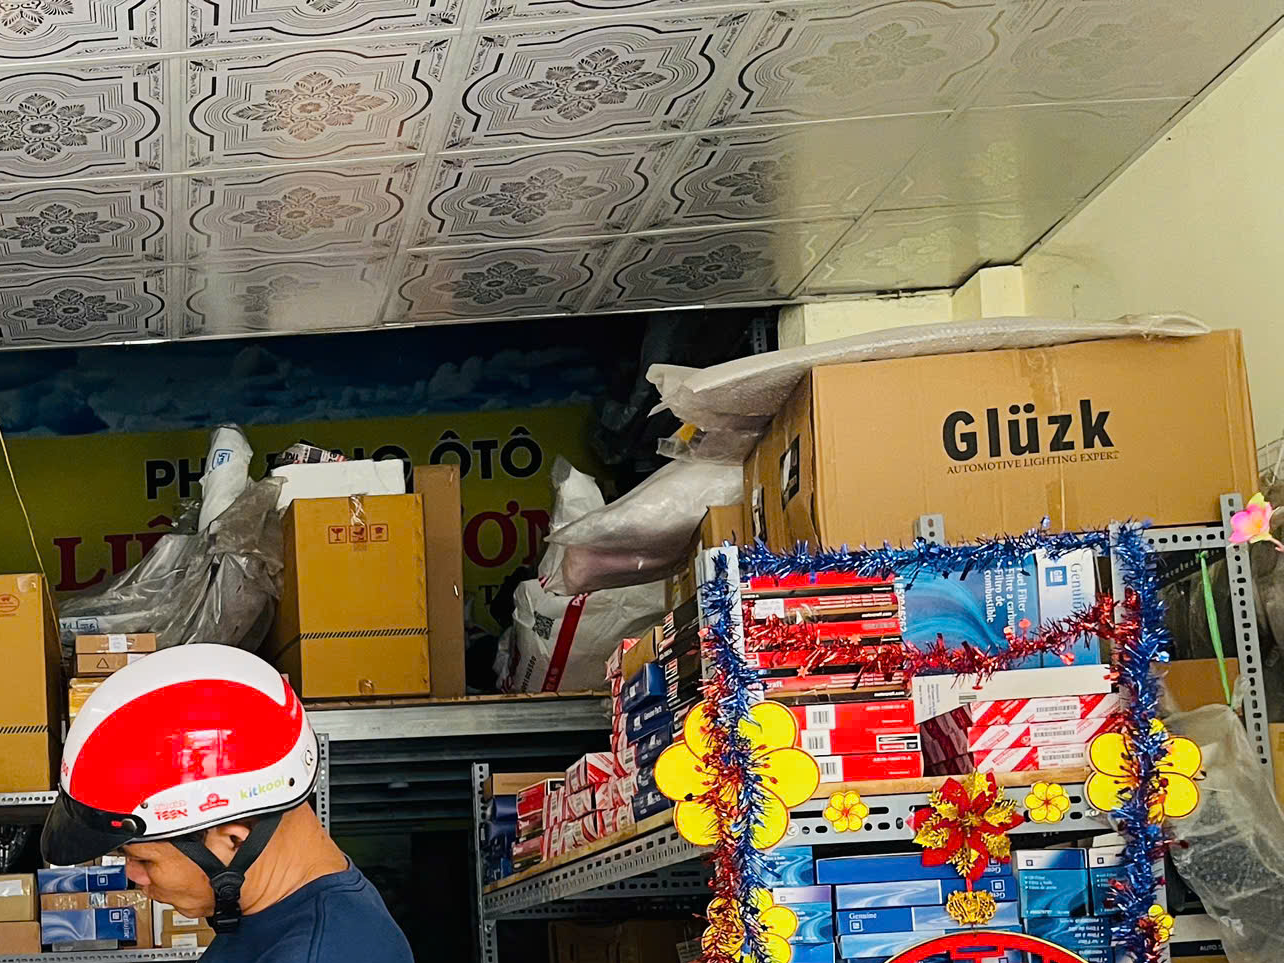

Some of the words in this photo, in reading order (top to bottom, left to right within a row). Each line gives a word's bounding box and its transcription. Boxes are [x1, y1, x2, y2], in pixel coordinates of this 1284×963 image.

[942, 399, 1115, 461] Glüzk
[429, 426, 543, 480] ÔTÔ
[947, 459, 1022, 474] AUTOMOTIVE
[1023, 454, 1077, 468] LIGHTING
[1080, 450, 1120, 462] EXPERT
[996, 569, 1006, 594] Filtro
[984, 569, 998, 624] combustible
[995, 595, 1006, 607] de
[1018, 588, 1028, 612] Filter
[240, 776, 284, 801] kitkool
[154, 807, 189, 821] TEEN
[122, 908, 130, 938] Genuine
[849, 912, 877, 920] Genuine
